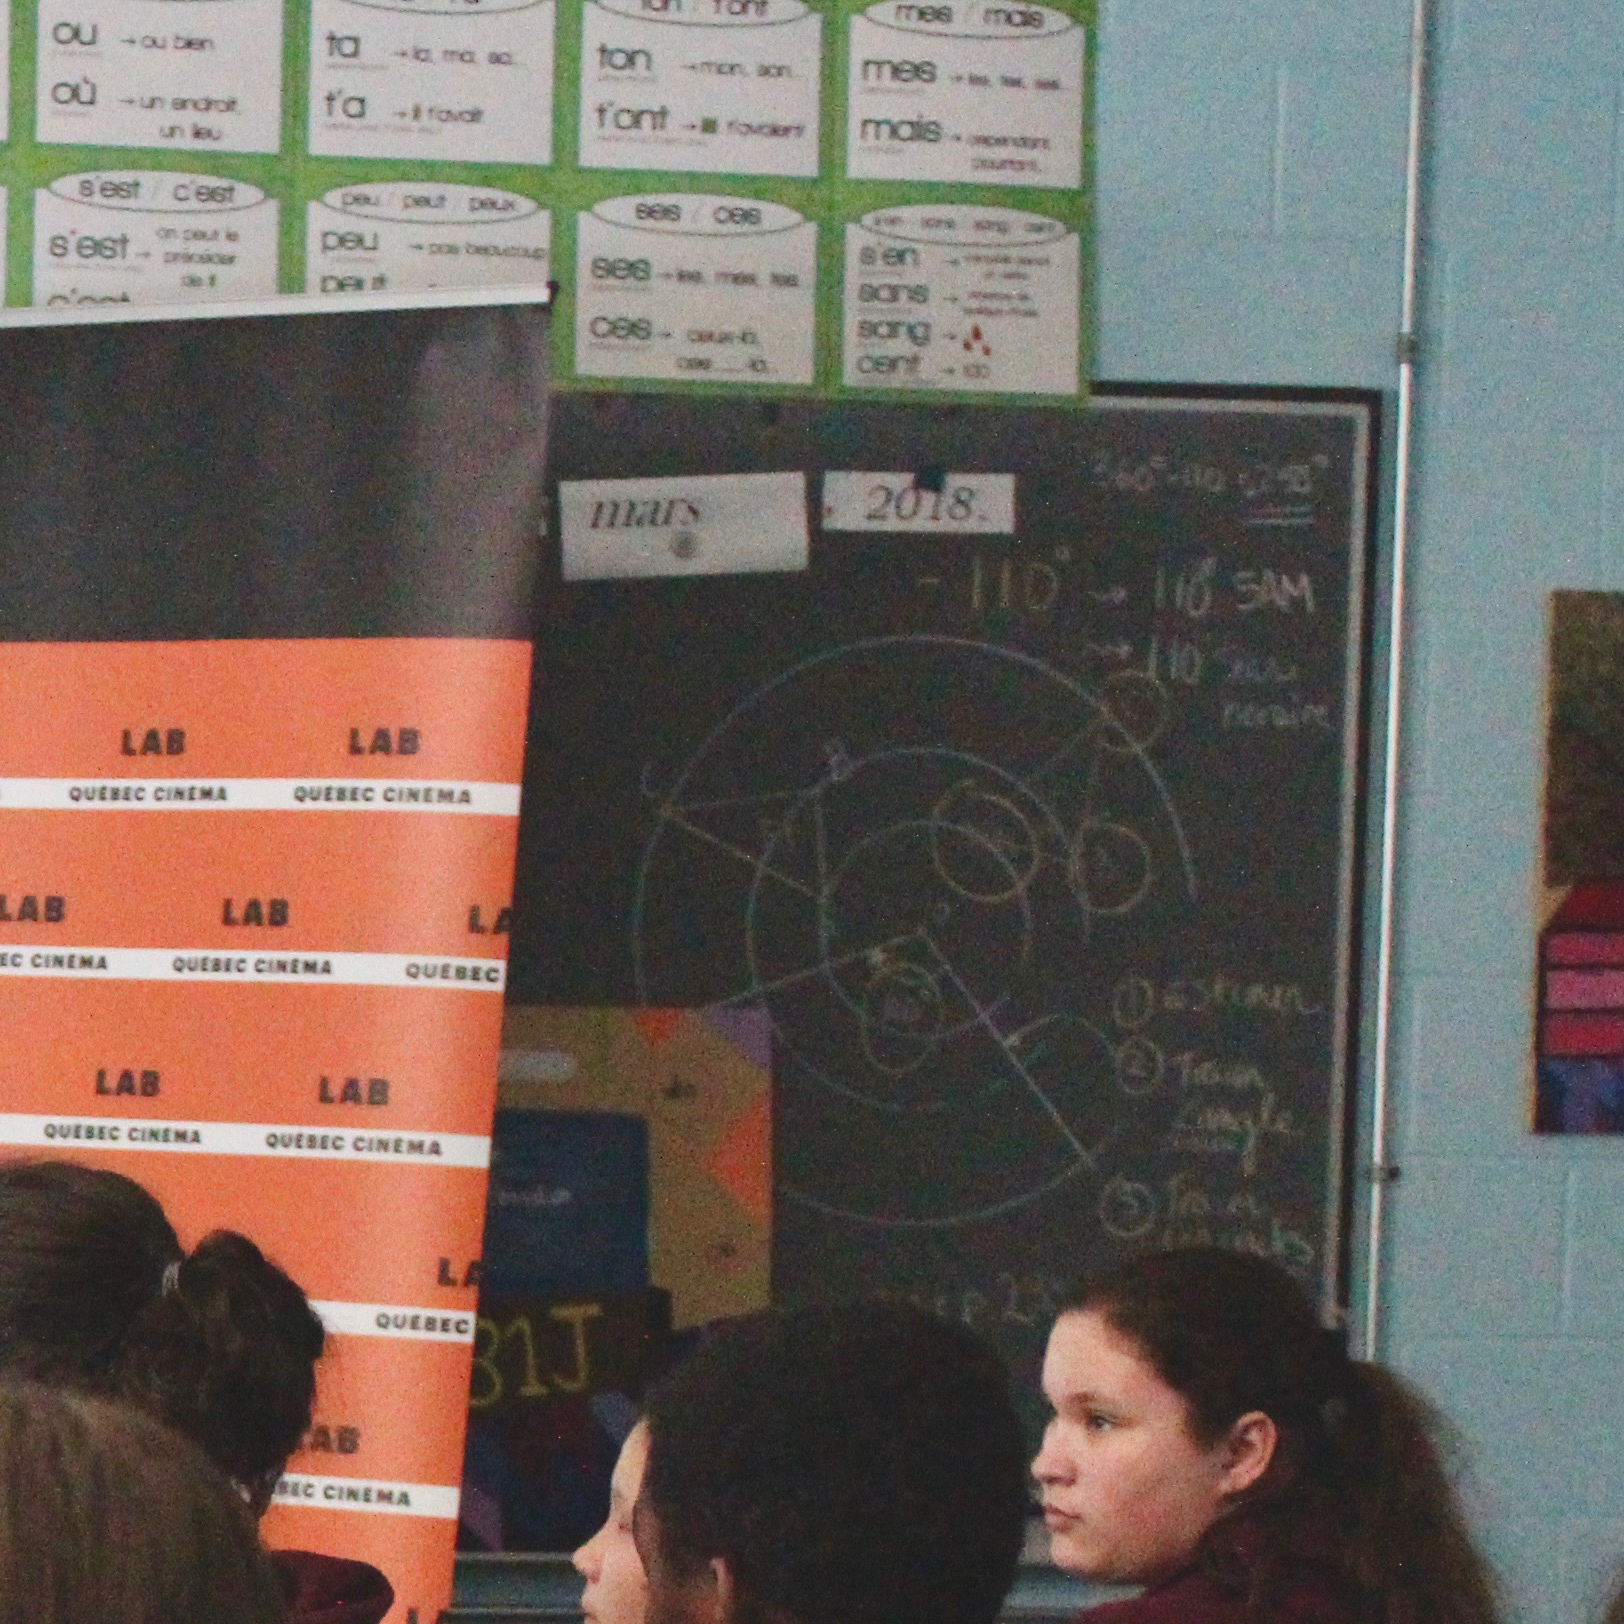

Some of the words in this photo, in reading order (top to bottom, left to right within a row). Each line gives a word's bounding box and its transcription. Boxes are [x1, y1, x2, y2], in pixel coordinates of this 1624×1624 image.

[52, 22, 98, 46] ou
[141, 36, 166, 50] ou
[326, 31, 360, 59] ta
[597, 44, 653, 72] ton
[863, 59, 938, 84] mes
[51, 75, 97, 106] où
[326, 88, 366, 119] t'a
[597, 101, 669, 132] t'ont
[861, 114, 946, 144] mais
[79, 176, 141, 199] s'est
[173, 180, 236, 204] c'est
[635, 203, 681, 222] ses
[713, 205, 762, 226] ces
[49, 230, 130, 260] s'est
[321, 231, 379, 255] peu
[591, 257, 652, 282] ses
[857, 282, 930, 305] sans
[589, 315, 653, 343] ces
[856, 319, 931, 348] sang
[855, 353, 921, 376] cent
[590, 498, 702, 530] mars
[121, 728, 186, 757] LAB
[349, 727, 420, 756] LAB
[222, 898, 289, 926] LAB
[468, 905, 513, 935] LA
[95, 1068, 160, 1097] LAB
[318, 1075, 389, 1106] LAB
[436, 1257, 481, 1286] LA
[303, 1425, 361, 1456] AB
